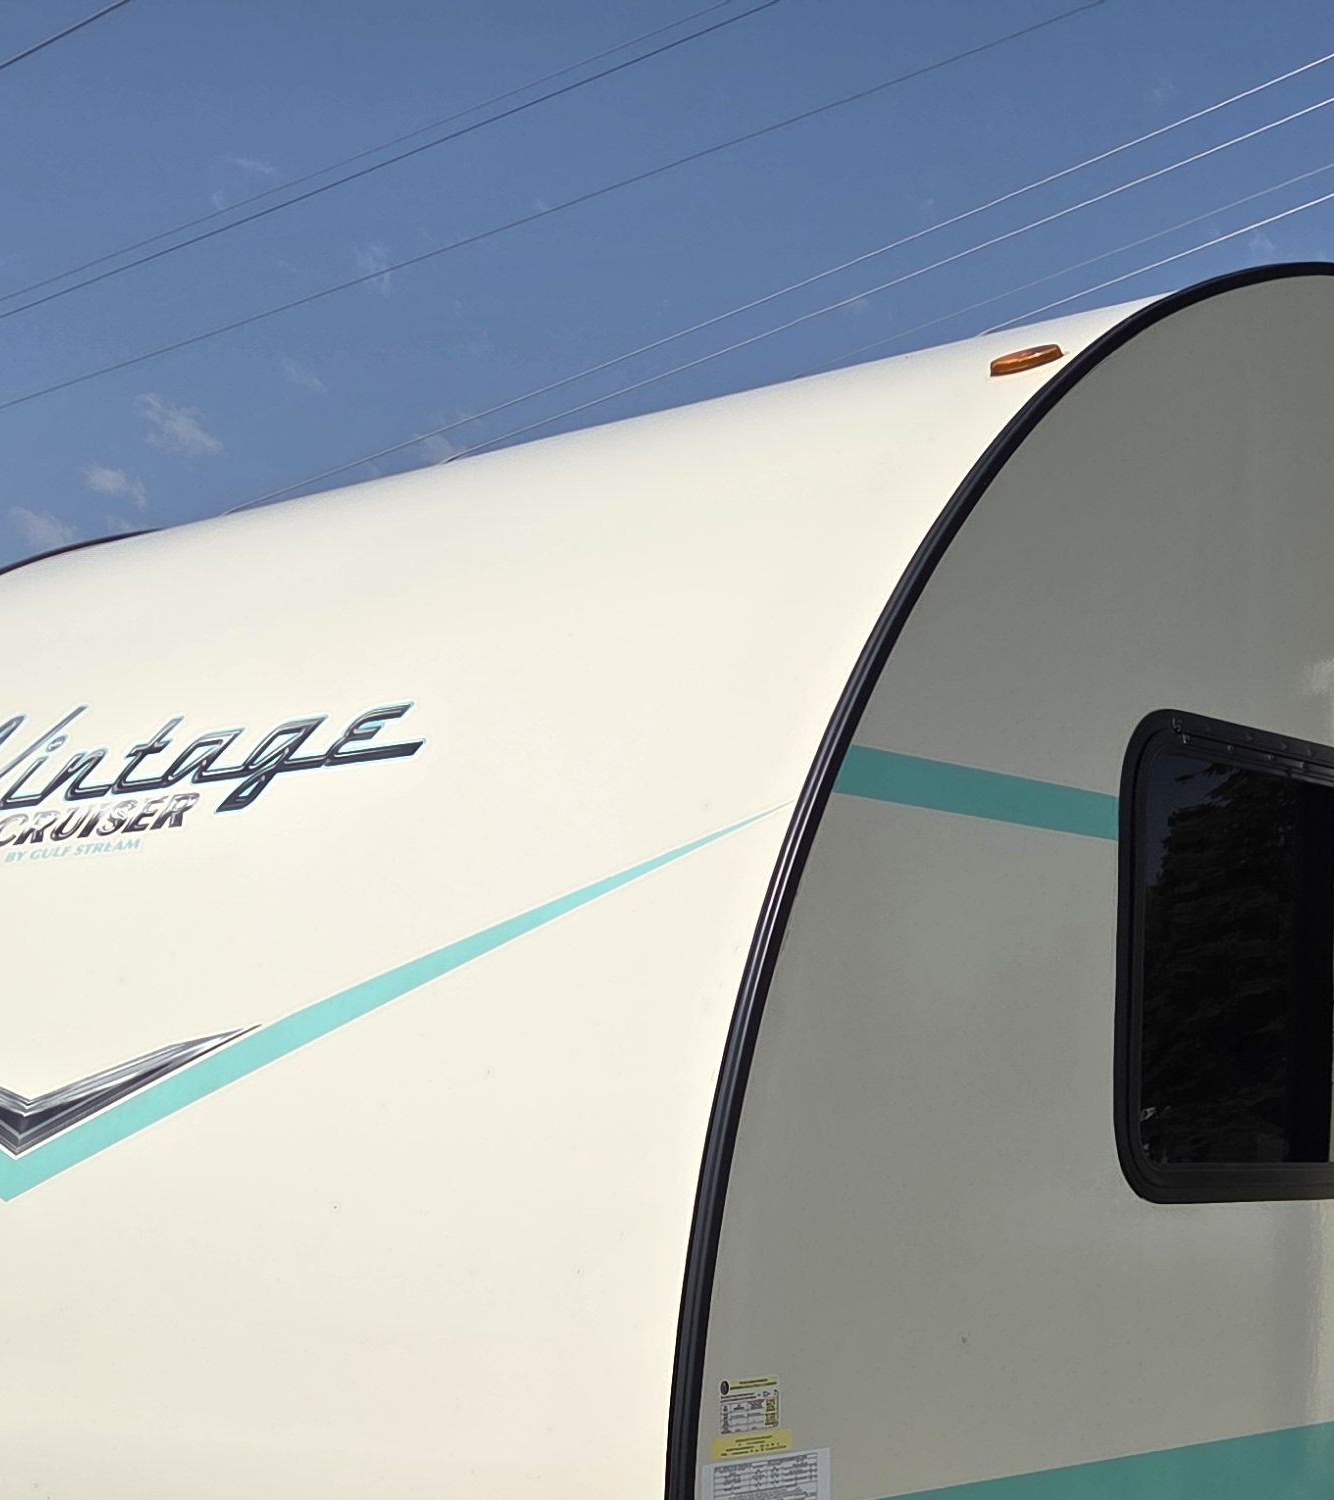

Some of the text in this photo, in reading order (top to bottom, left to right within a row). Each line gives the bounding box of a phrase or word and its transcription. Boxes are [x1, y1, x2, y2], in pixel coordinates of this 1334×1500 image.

[4, 838, 141, 863] BY GULF STREAM
